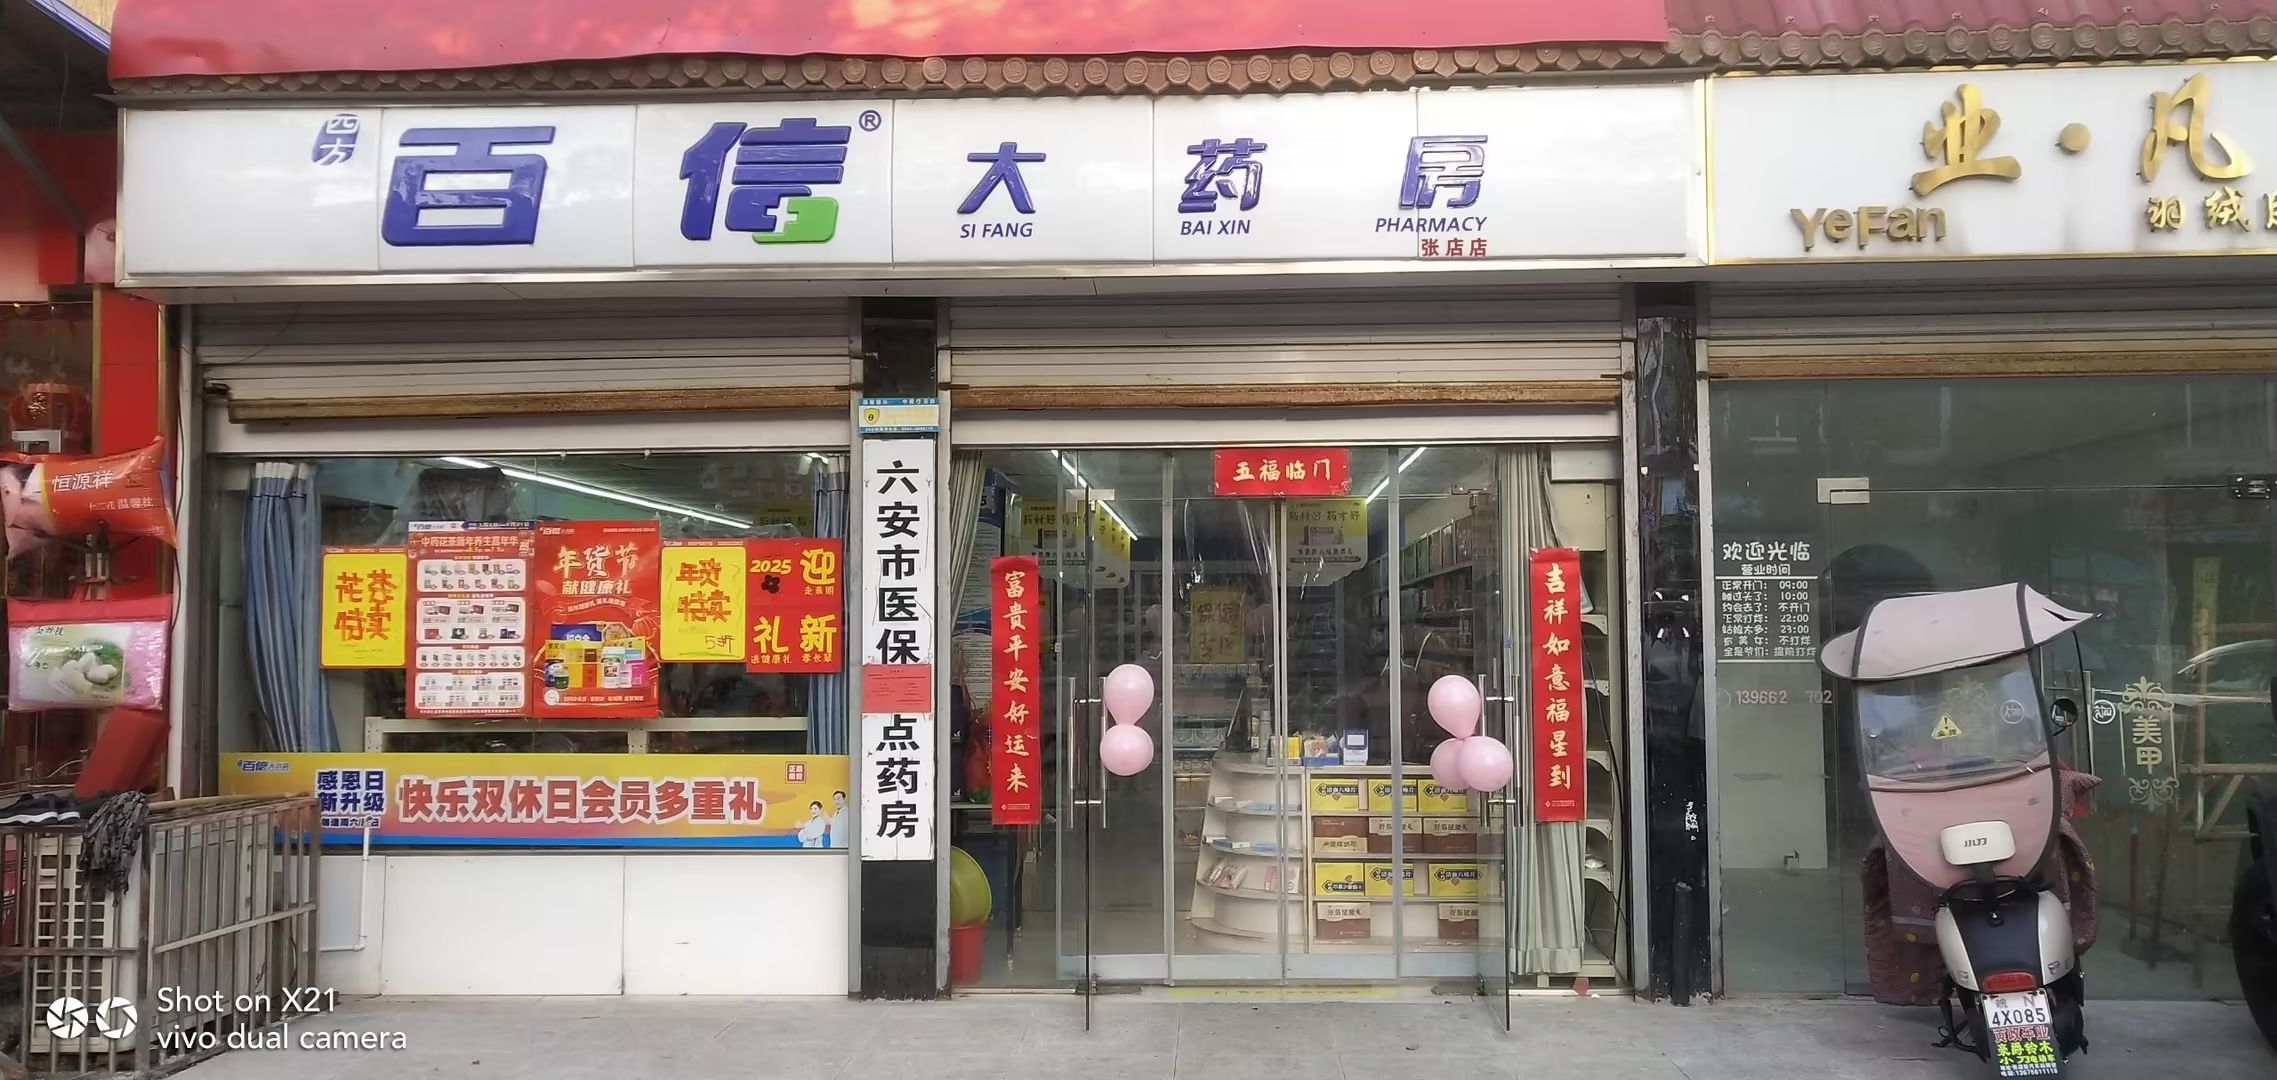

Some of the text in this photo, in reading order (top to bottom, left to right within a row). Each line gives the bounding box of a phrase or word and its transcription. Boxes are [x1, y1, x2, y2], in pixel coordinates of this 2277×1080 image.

[961, 217, 1488, 238] SI FANG BAI XIN PHARMACY
[1791, 205, 1946, 251] YeFan
[1420, 238, 1488, 257] 张店店
[1233, 458, 1330, 481] 五福临门
[52, 470, 115, 493] 恒源祥
[553, 542, 640, 578] 年货节
[1722, 541, 1811, 561] 欢迎光临
[676, 558, 722, 587] 年货
[750, 559, 792, 575] 2025
[800, 548, 836, 585] 迎
[1741, 564, 1791, 575] 营业时间
[562, 580, 632, 595] 献健康礼
[1780, 581, 1808, 589] 09:00
[1781, 592, 1808, 600] 10:00
[1779, 603, 1810, 612] 不开门
[1781, 614, 1808, 622] 22:00
[753, 615, 789, 654] 礼
[800, 614, 837, 654] 新
[1780, 625, 1809, 633] 23:00
[705, 636, 735, 653] 5折
[876, 460, 920, 838] 六安市医保点药房
[751, 654, 792, 664] 送健康礼
[1003, 570, 1030, 793] 富贵平安好运来
[1542, 562, 1571, 790] 吉祥如意福星到
[2132, 714, 2162, 774] 美甲
[317, 770, 384, 790] 感恩日
[318, 793, 385, 812] 新升级
[399, 778, 762, 820] 快乐双休日会员多重礼
[1992, 1008, 2046, 1025] 4X085
